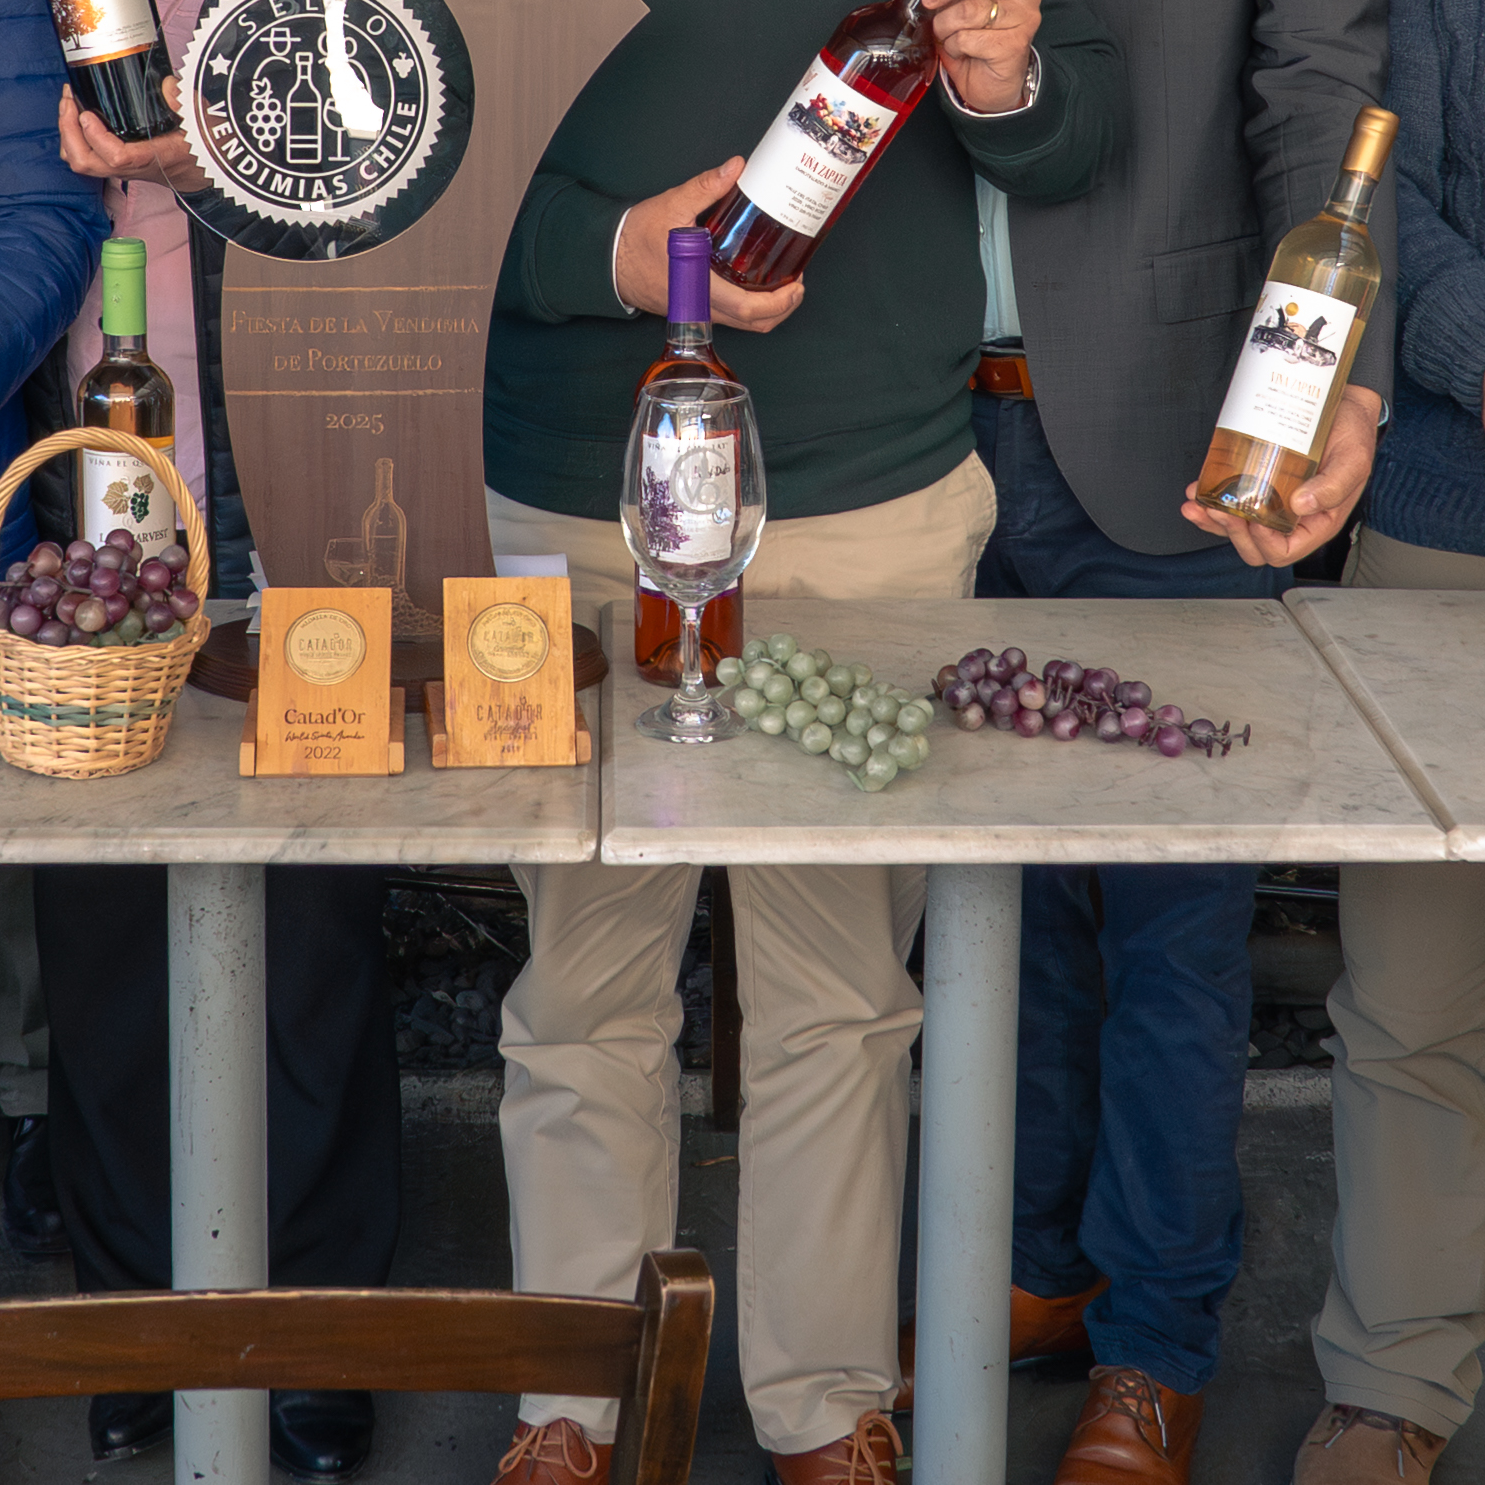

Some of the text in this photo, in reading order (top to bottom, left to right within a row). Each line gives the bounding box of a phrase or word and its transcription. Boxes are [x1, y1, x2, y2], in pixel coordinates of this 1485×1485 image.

[206, 100, 348, 199] VENDIMIAS
[359, 101, 417, 181] CHILE
[800, 152, 848, 187] VIÑA ZAPATA
[325, 413, 385, 435] 2025
[133, 527, 169, 543] ARVEST
[284, 707, 366, 725] Catad'Or
[304, 745, 342, 760] 2022
